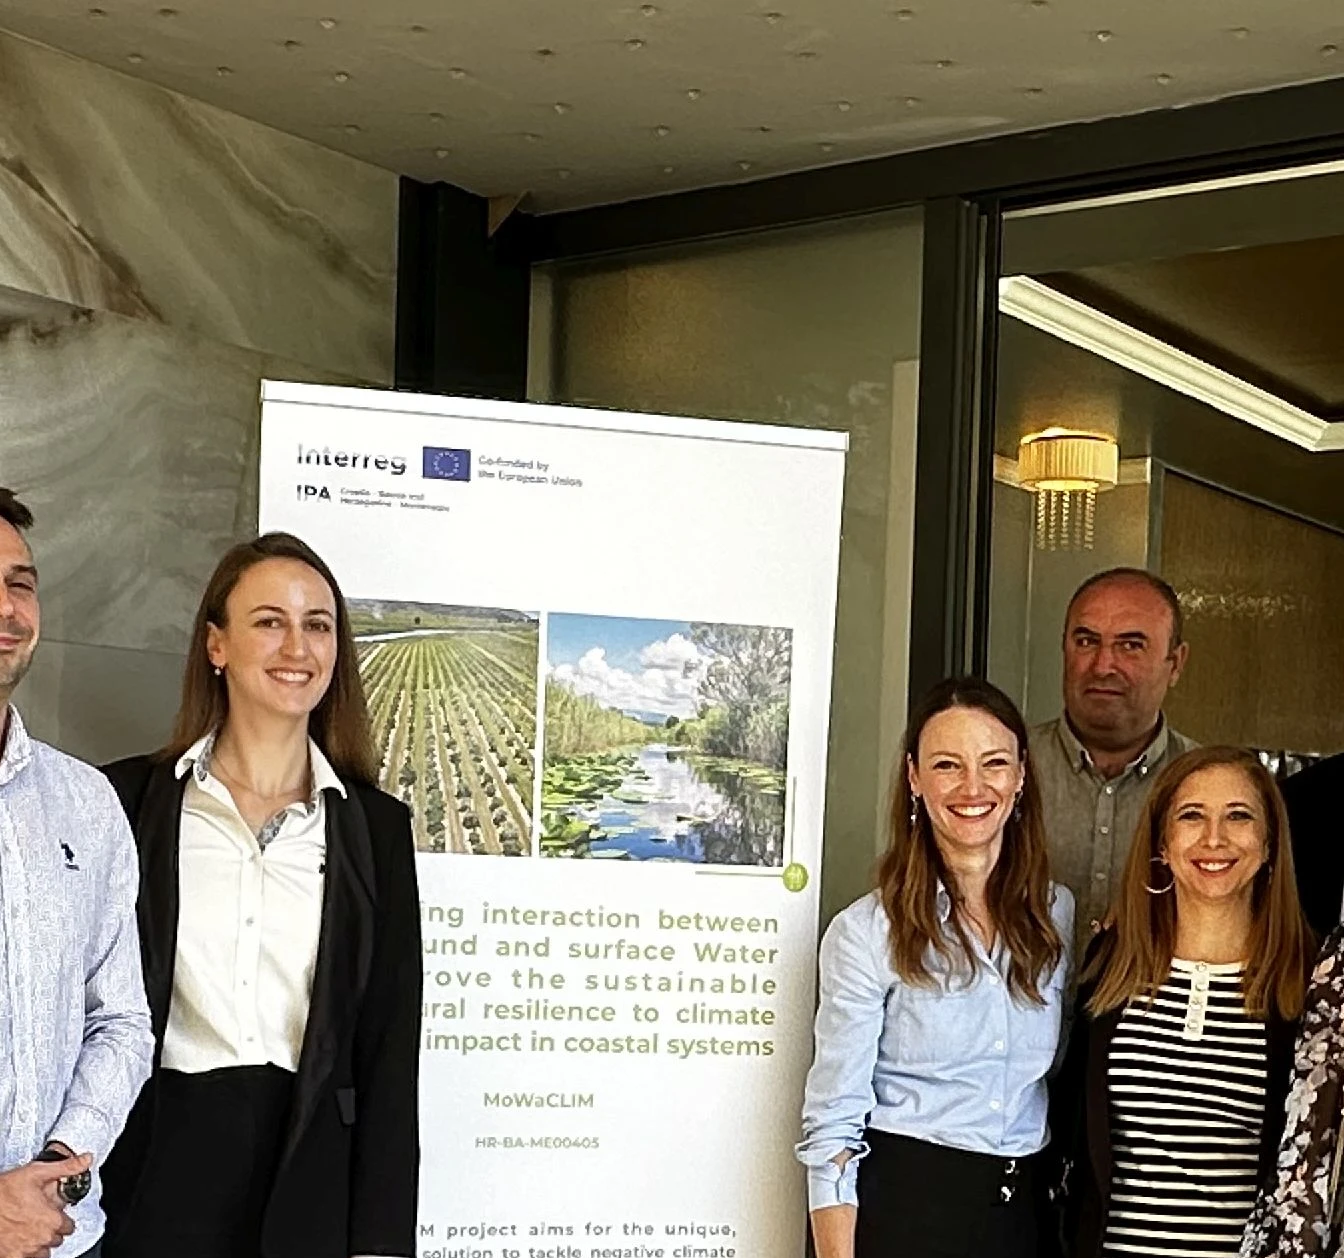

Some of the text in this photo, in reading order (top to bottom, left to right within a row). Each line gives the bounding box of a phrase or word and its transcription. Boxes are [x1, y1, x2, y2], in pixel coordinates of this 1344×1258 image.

[297, 443, 407, 475] Interreg
[297, 485, 331, 501] IPA
[483, 901, 641, 930] interaction
[659, 909, 779, 934] between
[495, 936, 551, 958] and
[568, 937, 676, 961] surface
[694, 942, 779, 965] Water
[426, 967, 777, 995] ove the sustainable
[483, 998, 616, 1022] resilience
[633, 1004, 659, 1023] to
[676, 1004, 776, 1026] climate
[425, 1028, 775, 1059] impact in coastal systems
[483, 1092, 594, 1108] MoWaCLIM
[447, 1221, 517, 1240] project
[529, 1222, 574, 1236] aims
[584, 1222, 612, 1236] for
[623, 1222, 654, 1236] the
[664, 1221, 737, 1239] unique,
[673, 1244, 736, 1258] climate
